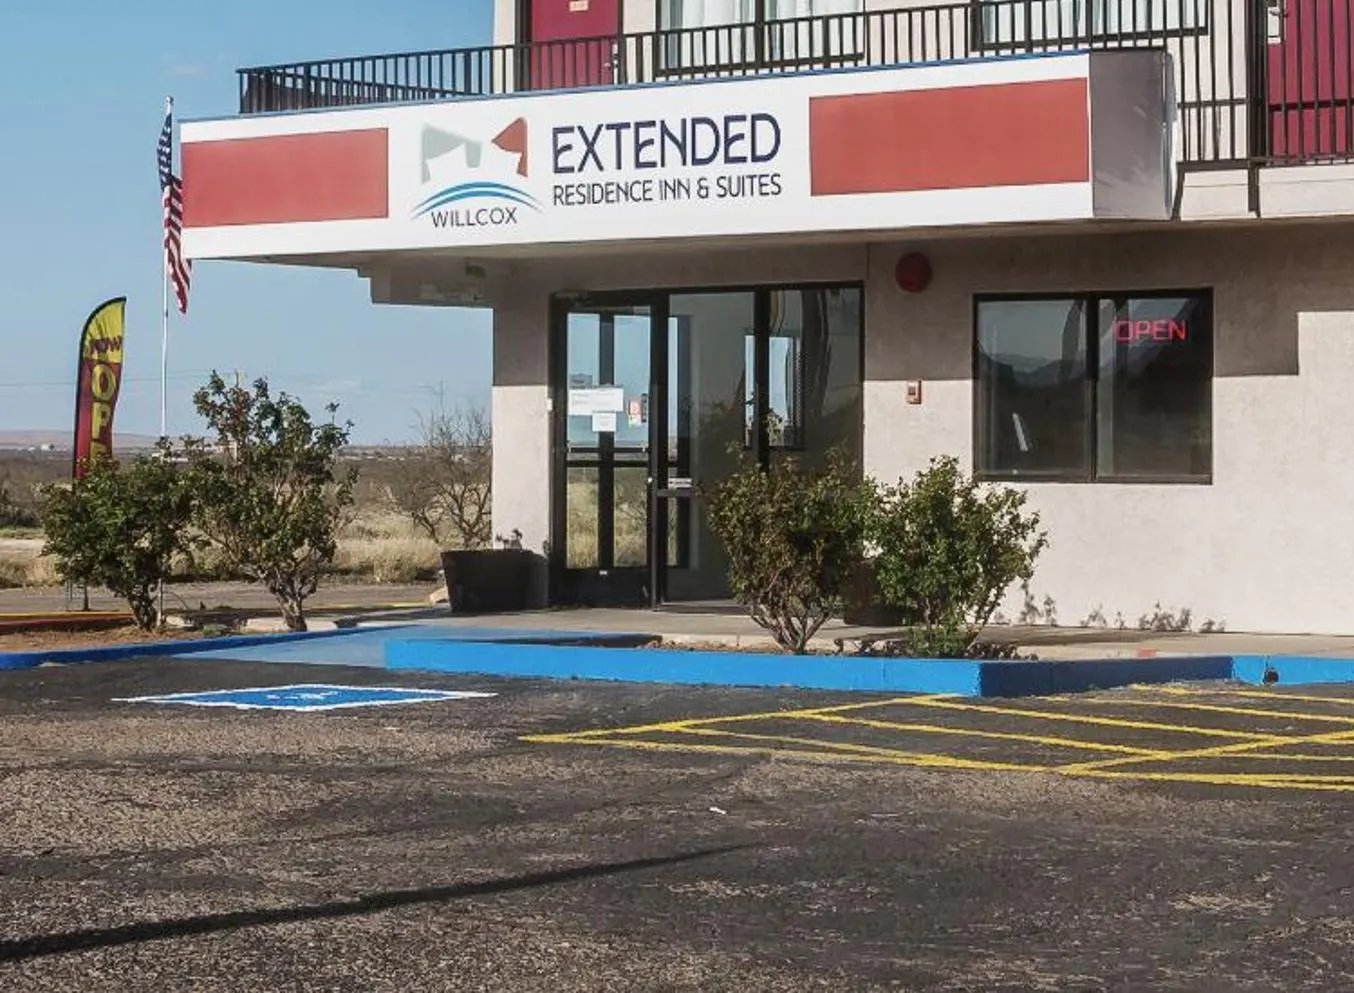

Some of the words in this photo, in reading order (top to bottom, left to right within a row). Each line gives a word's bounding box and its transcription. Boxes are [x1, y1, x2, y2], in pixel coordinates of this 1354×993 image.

[552, 112, 782, 175] EXTENDED
[552, 179, 654, 207] RESIDENCE
[658, 177, 692, 201] INN
[696, 176, 710, 200] &
[716, 173, 783, 199] SUITES
[430, 206, 519, 228] WILLCOX
[1115, 319, 1186, 342] OPEN
